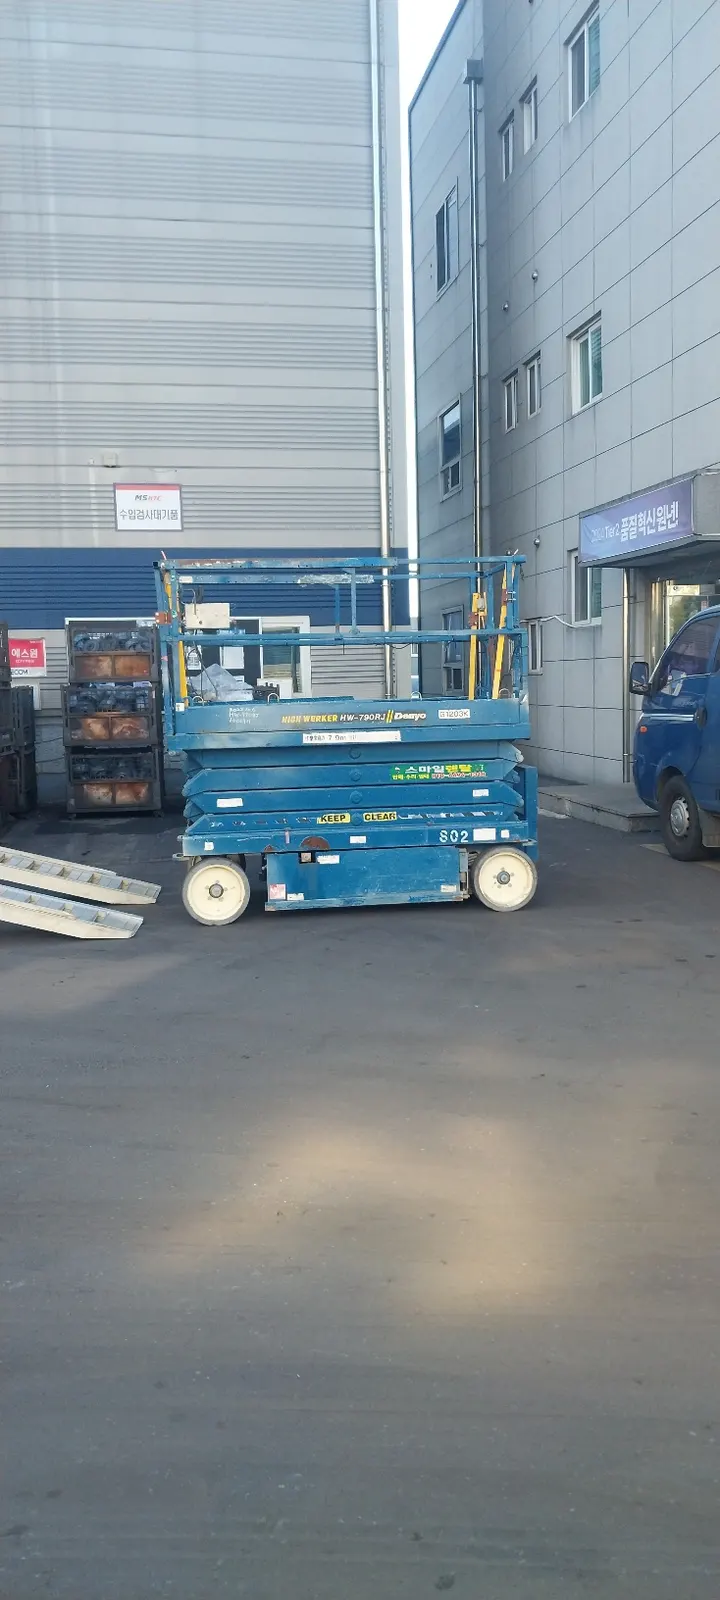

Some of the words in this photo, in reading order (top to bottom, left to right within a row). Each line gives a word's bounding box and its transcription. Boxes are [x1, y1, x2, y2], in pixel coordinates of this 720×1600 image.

[119, 509, 179, 521] 수입검사대기품
[11, 648, 38, 659] 에스원
[339, 712, 385, 722] HW-790RJ
[394, 712, 427, 721] Denyo
[320, 814, 346, 823] KEEP
[364, 812, 396, 821] CLEAR
